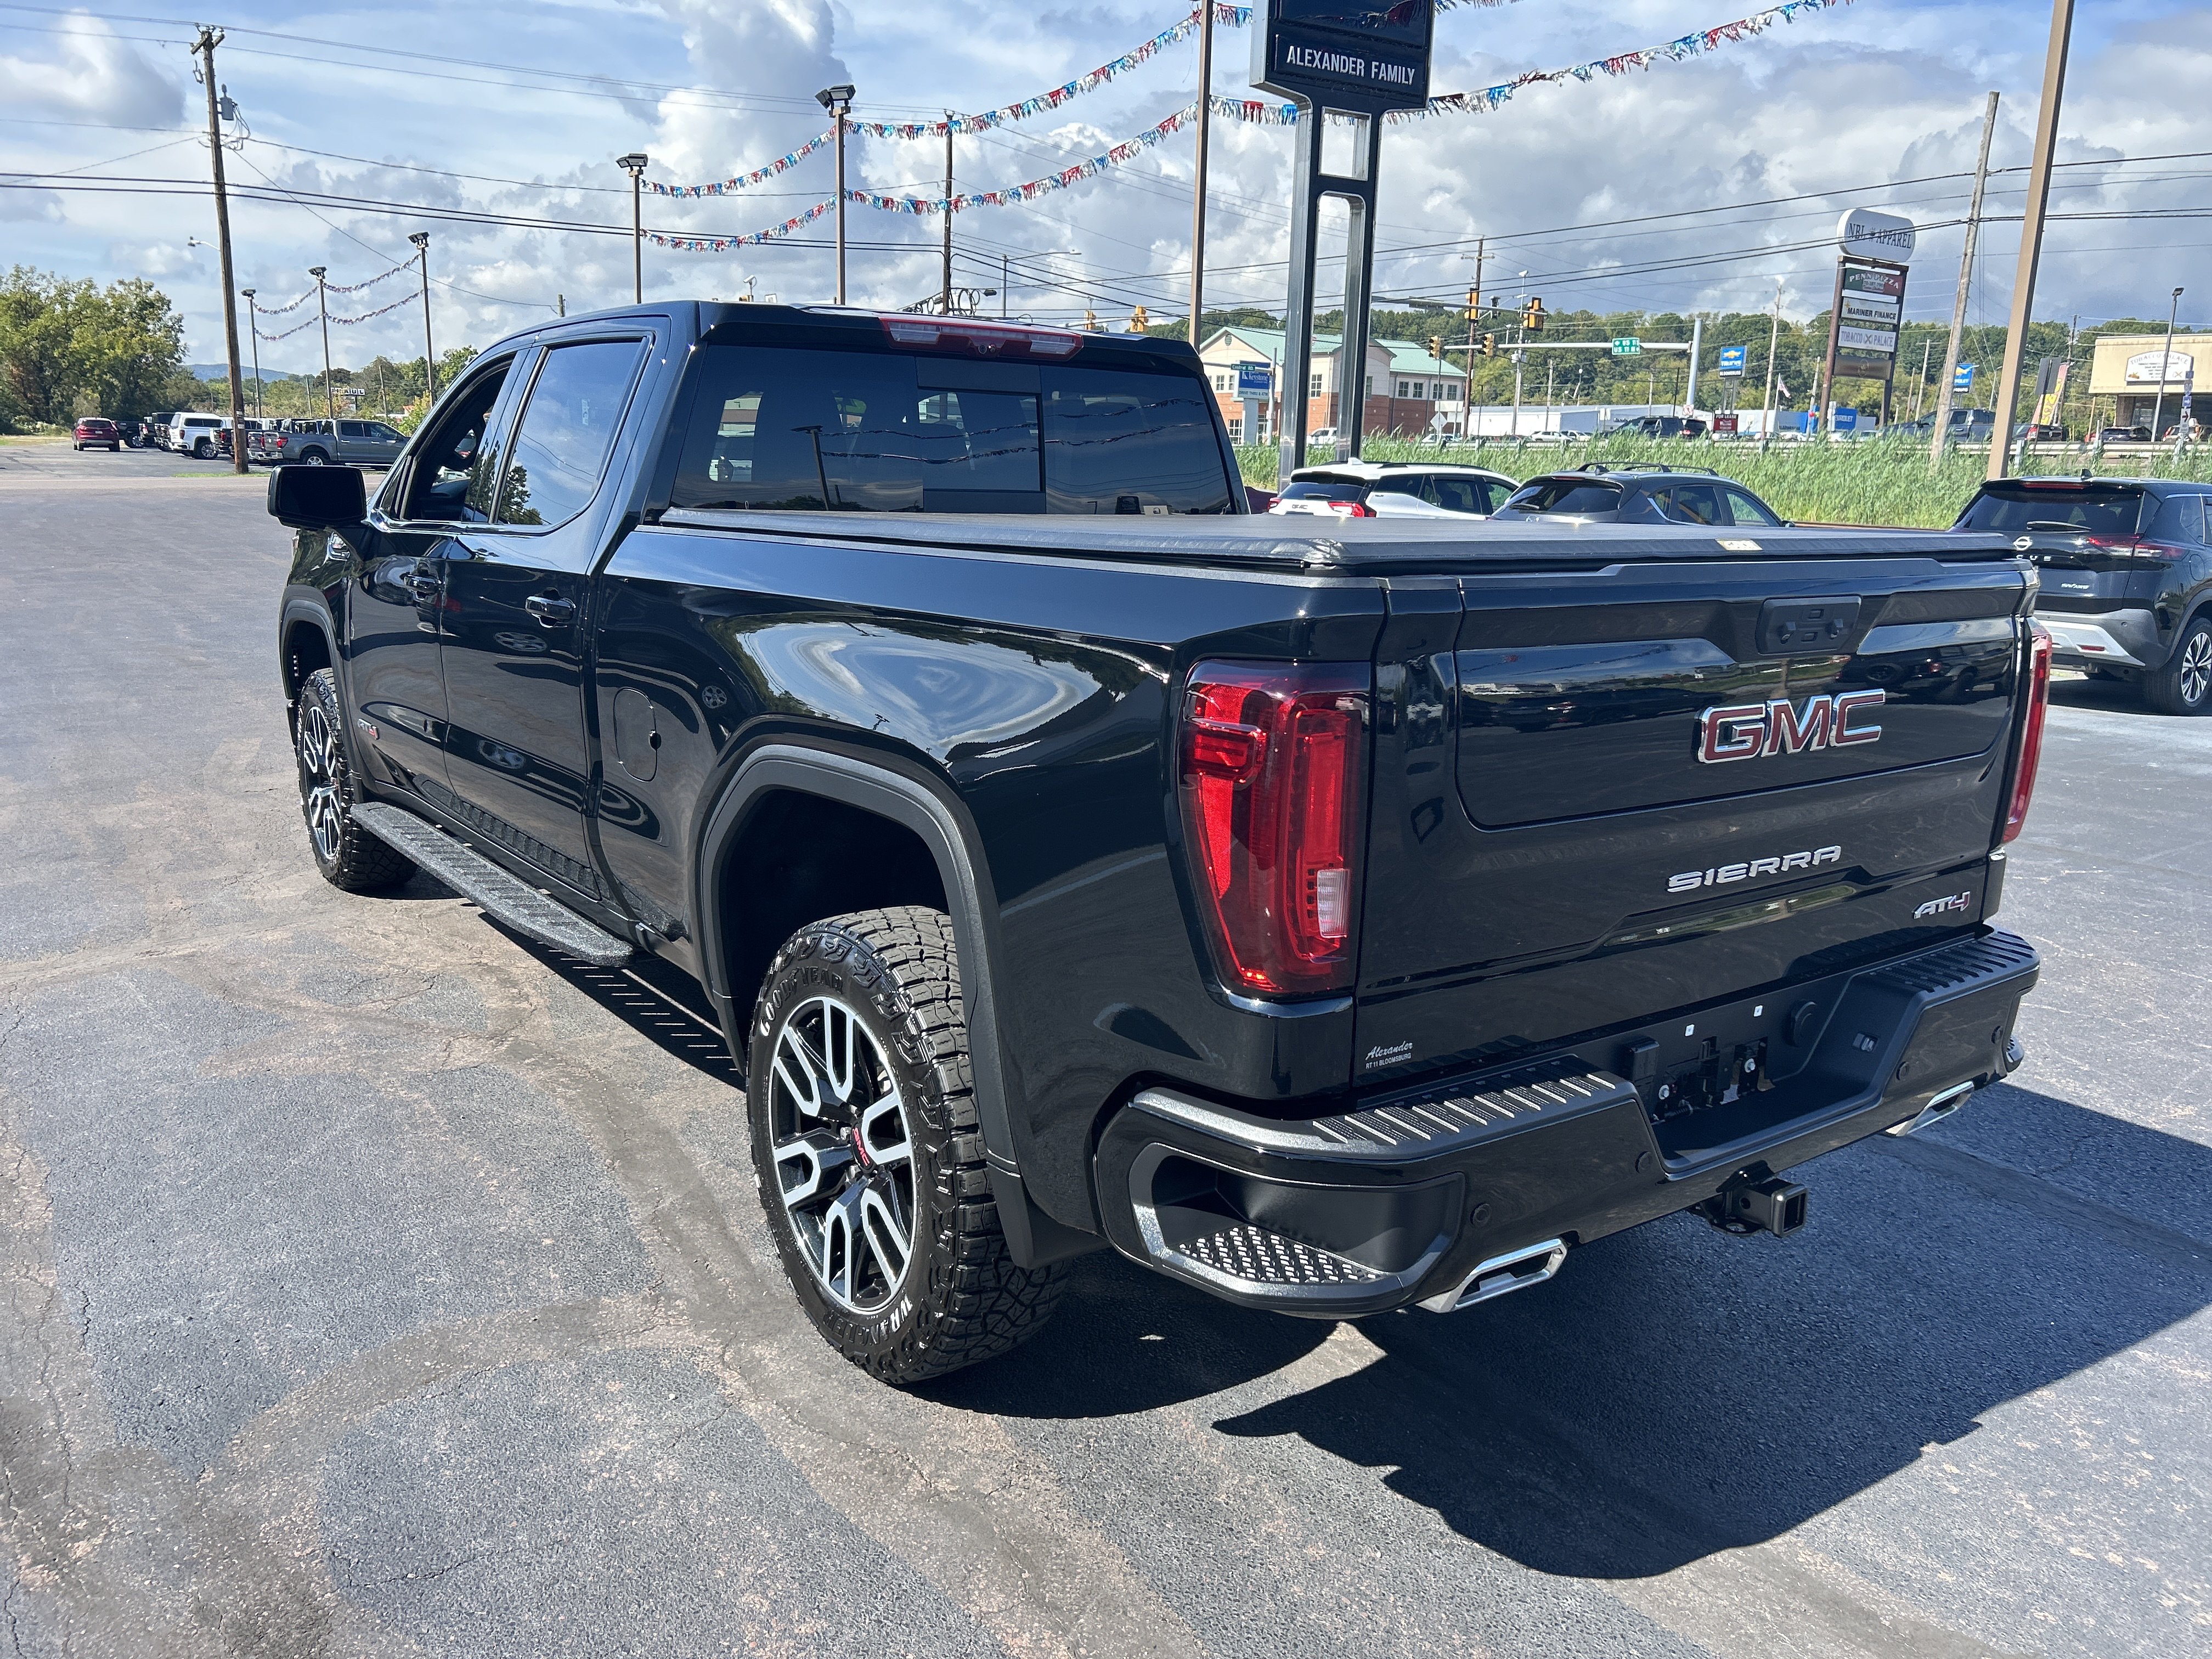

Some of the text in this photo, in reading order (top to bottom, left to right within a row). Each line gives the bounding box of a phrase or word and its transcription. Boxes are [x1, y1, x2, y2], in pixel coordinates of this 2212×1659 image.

[1286, 45, 1415, 86] ALEXANDER FAMILY
[1876, 228, 1911, 249] APPAREL
[1849, 273, 1872, 283] PENN
[1875, 274, 1899, 289] PIZZA
[1847, 307, 1897, 320] MARINER FINANCE
[1841, 331, 1894, 347] TOBACCO PALACE
[357, 718, 378, 741] AT4
[1695, 689, 1886, 764] GMC
[1667, 845, 1842, 893] SIERRA
[1914, 891, 1971, 920] AT4
[759, 966, 844, 1037] GOODYEAR
[1365, 1040, 1414, 1061] Alexander
[1365, 1052, 1412, 1070] RT 11 BLOOMSBURG
[854, 1127, 870, 1166] GMC
